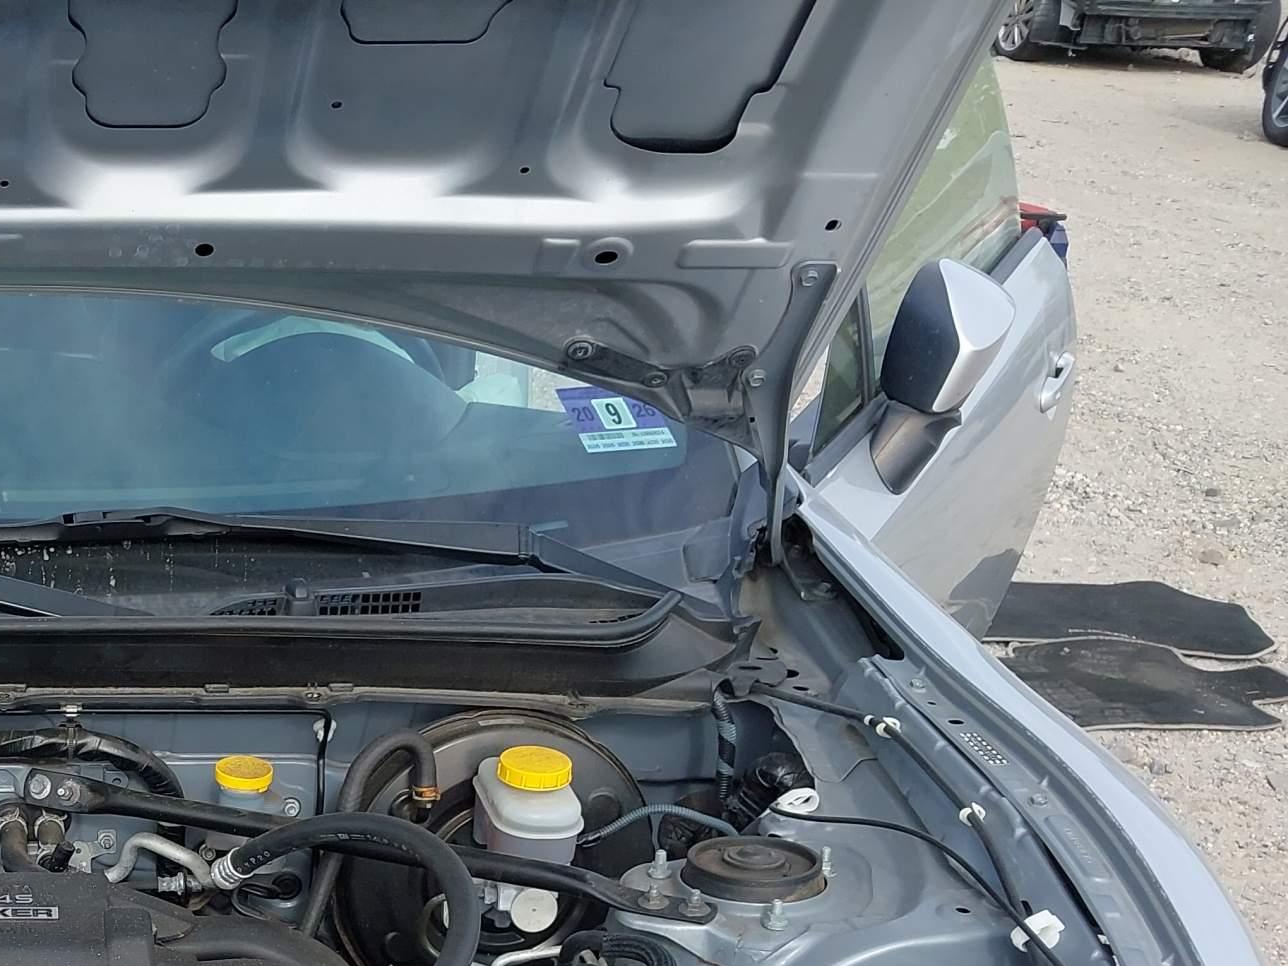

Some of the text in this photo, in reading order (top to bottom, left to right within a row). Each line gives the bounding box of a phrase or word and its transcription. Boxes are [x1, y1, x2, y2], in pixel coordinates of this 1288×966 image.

[572, 403, 656, 425] 20 9 26
